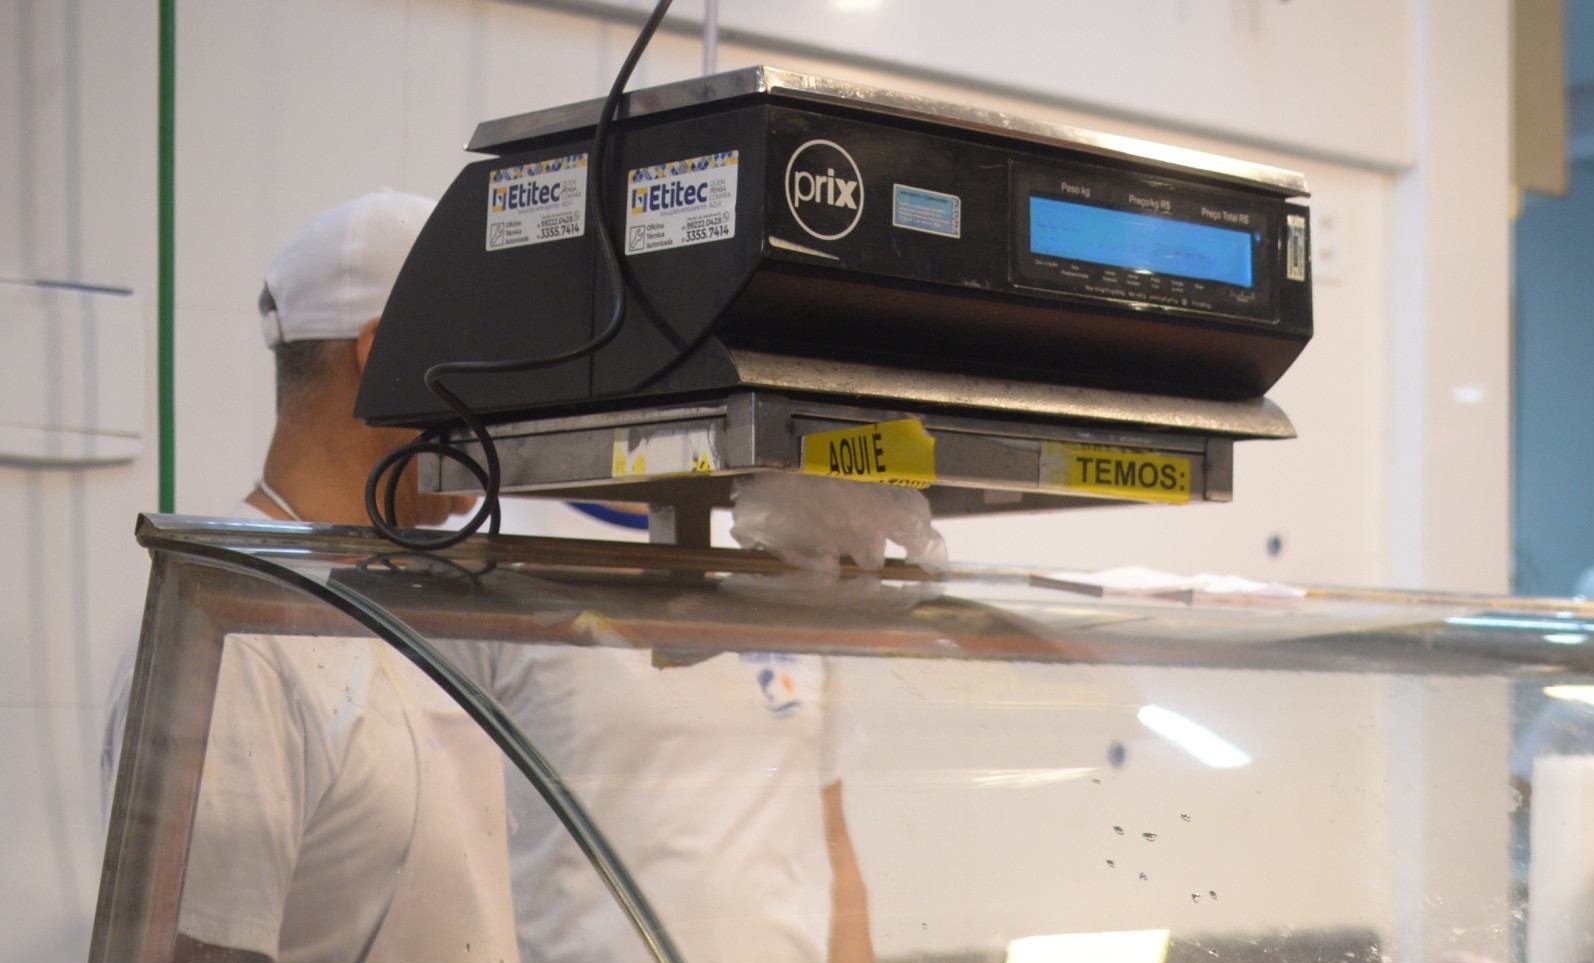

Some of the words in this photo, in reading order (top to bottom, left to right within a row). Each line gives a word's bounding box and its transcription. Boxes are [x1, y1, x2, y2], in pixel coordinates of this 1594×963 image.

[508, 181, 561, 210] Etitec
[649, 181, 708, 211] Etitec
[794, 167, 858, 210] prix
[1061, 182, 1080, 195] Peso
[1080, 187, 1091, 198] kg
[1222, 210, 1238, 222] Total
[540, 224, 580, 239] 3355.7414
[686, 225, 729, 242] 3355.7414
[829, 435, 871, 475] AQUI
[1076, 456, 1185, 491] TEMOS:
